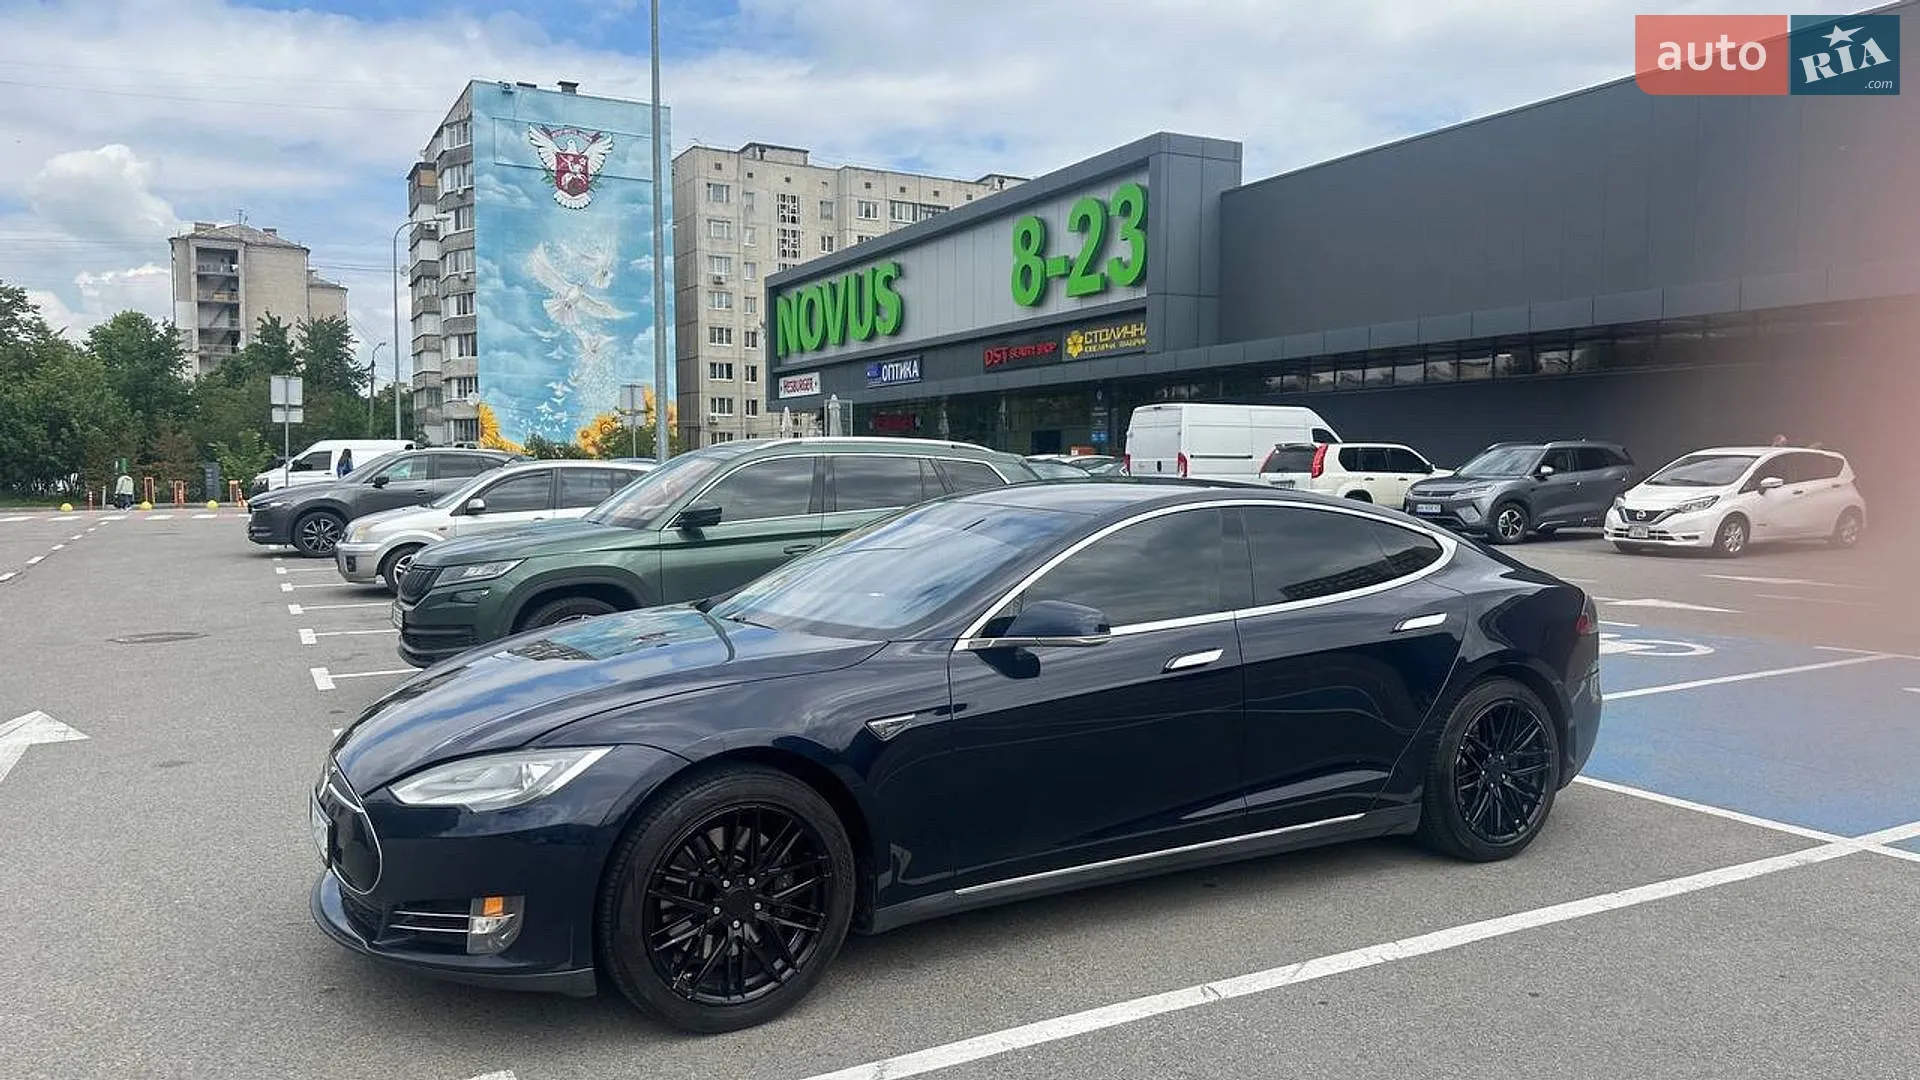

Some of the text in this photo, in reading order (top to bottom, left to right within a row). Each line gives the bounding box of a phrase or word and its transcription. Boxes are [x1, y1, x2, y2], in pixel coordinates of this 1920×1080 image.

[1011, 182, 1147, 307] 8-23
[777, 261, 904, 357] NOVUS
[881, 359, 920, 382] ОПТИКА
